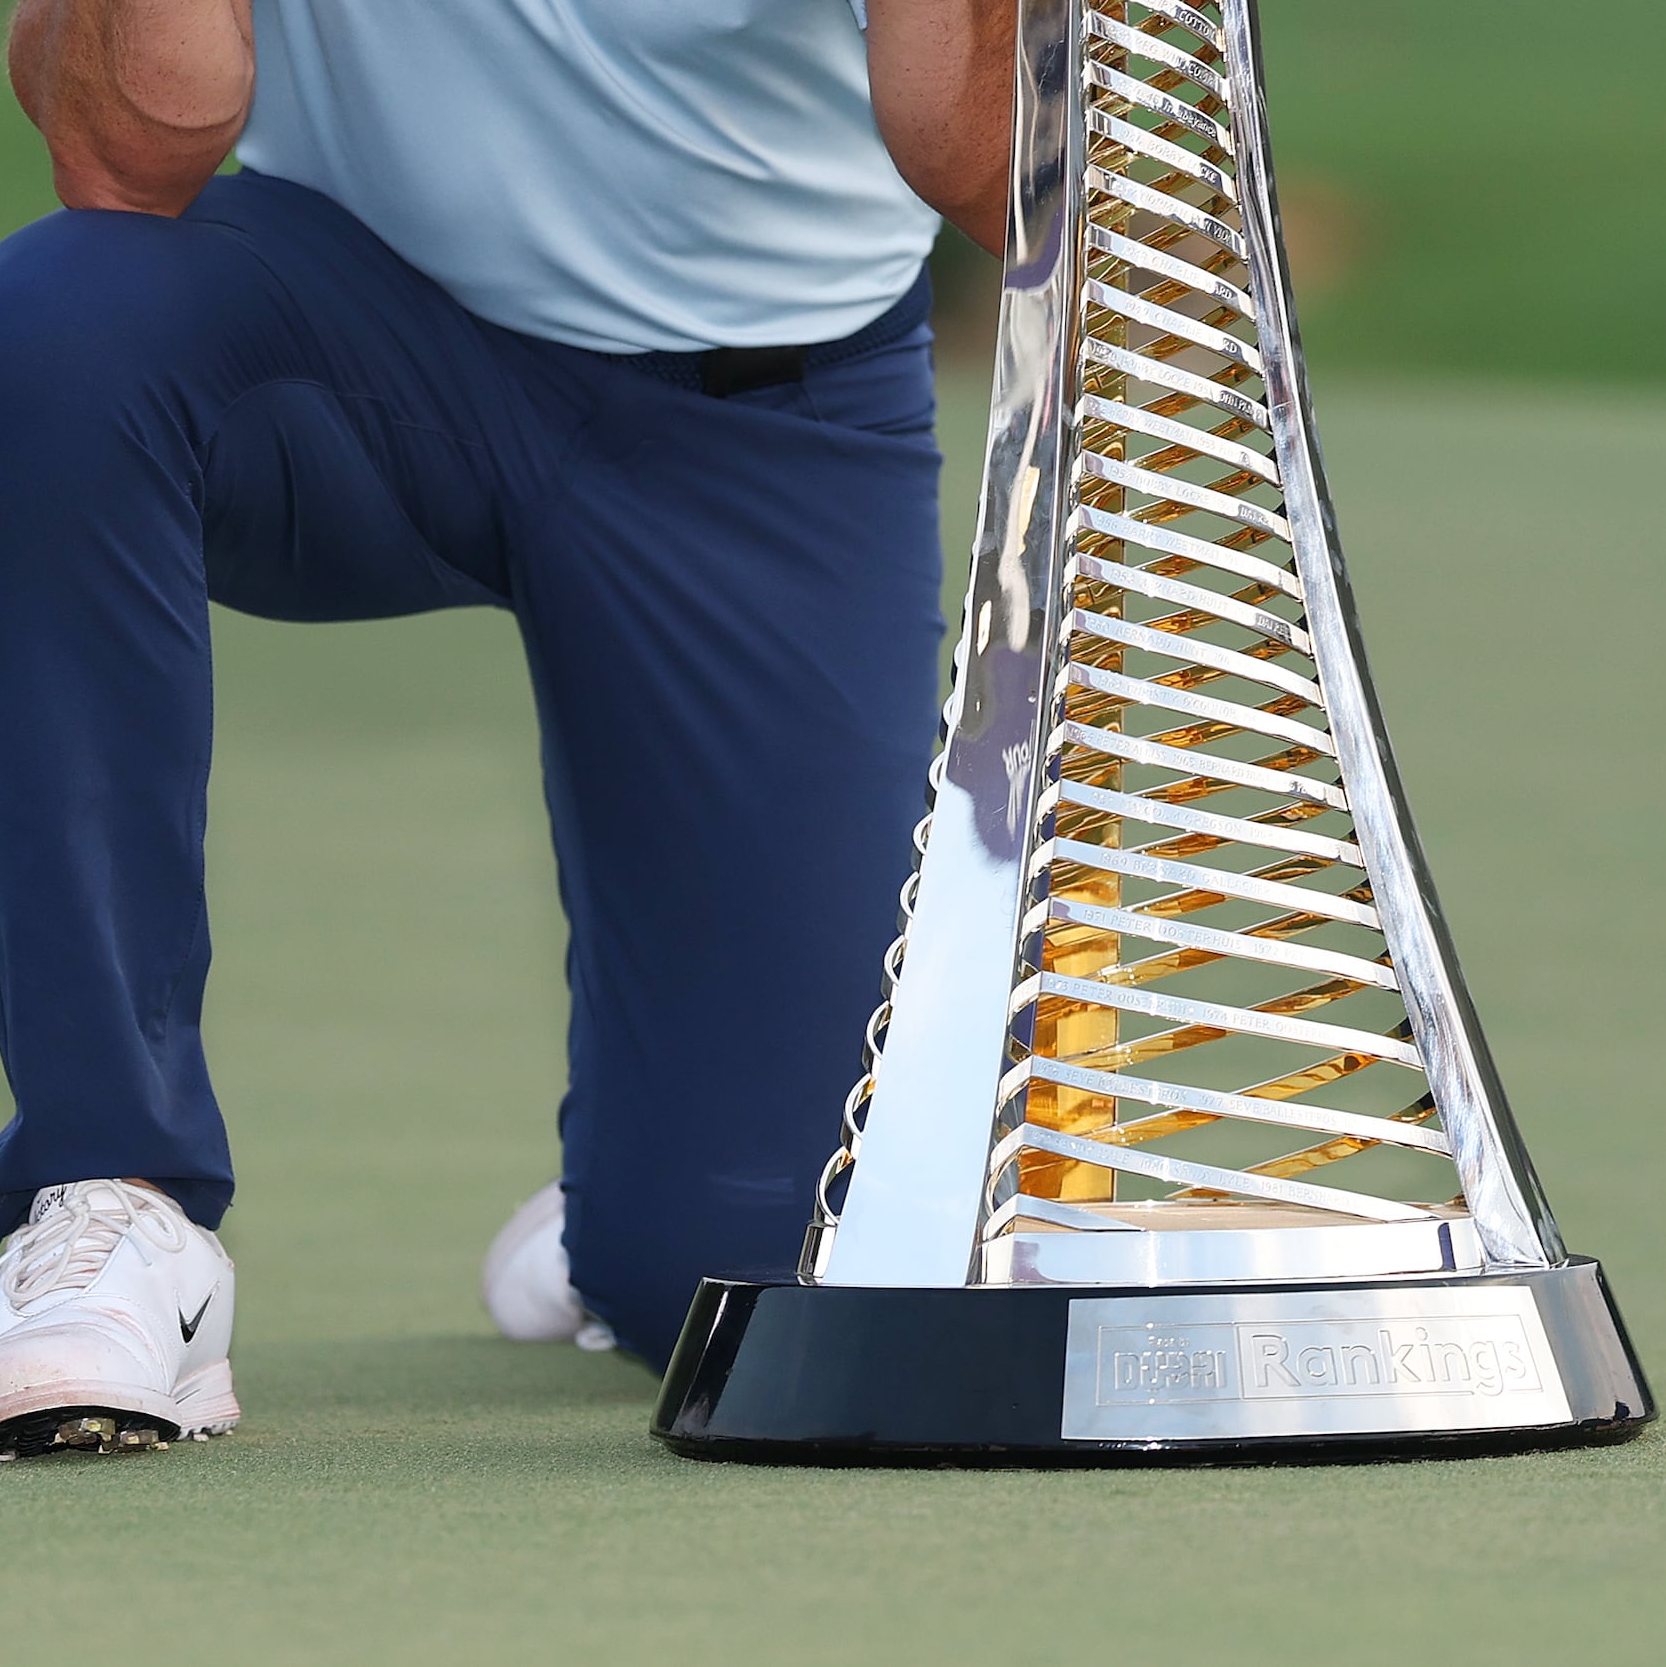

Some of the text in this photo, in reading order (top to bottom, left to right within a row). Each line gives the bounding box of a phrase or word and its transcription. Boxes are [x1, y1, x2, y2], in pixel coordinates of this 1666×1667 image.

[1083, 909, 1104, 922] 1971
[1109, 914, 1151, 932] PETER
[1158, 924, 1241, 950] OOSTERHUIS
[1072, 983, 1112, 1000] PETER
[1201, 1007, 1227, 1022] 1974
[1231, 1012, 1269, 1029] PETER
[1065, 1069, 1094, 1084] SEVE
[1228, 1098, 1260, 1113] SEVE
[1218, 1173, 1251, 1188] LYLE
[1260, 1180, 1284, 1193] 1981
[1252, 1327, 1526, 1396] Rankings
